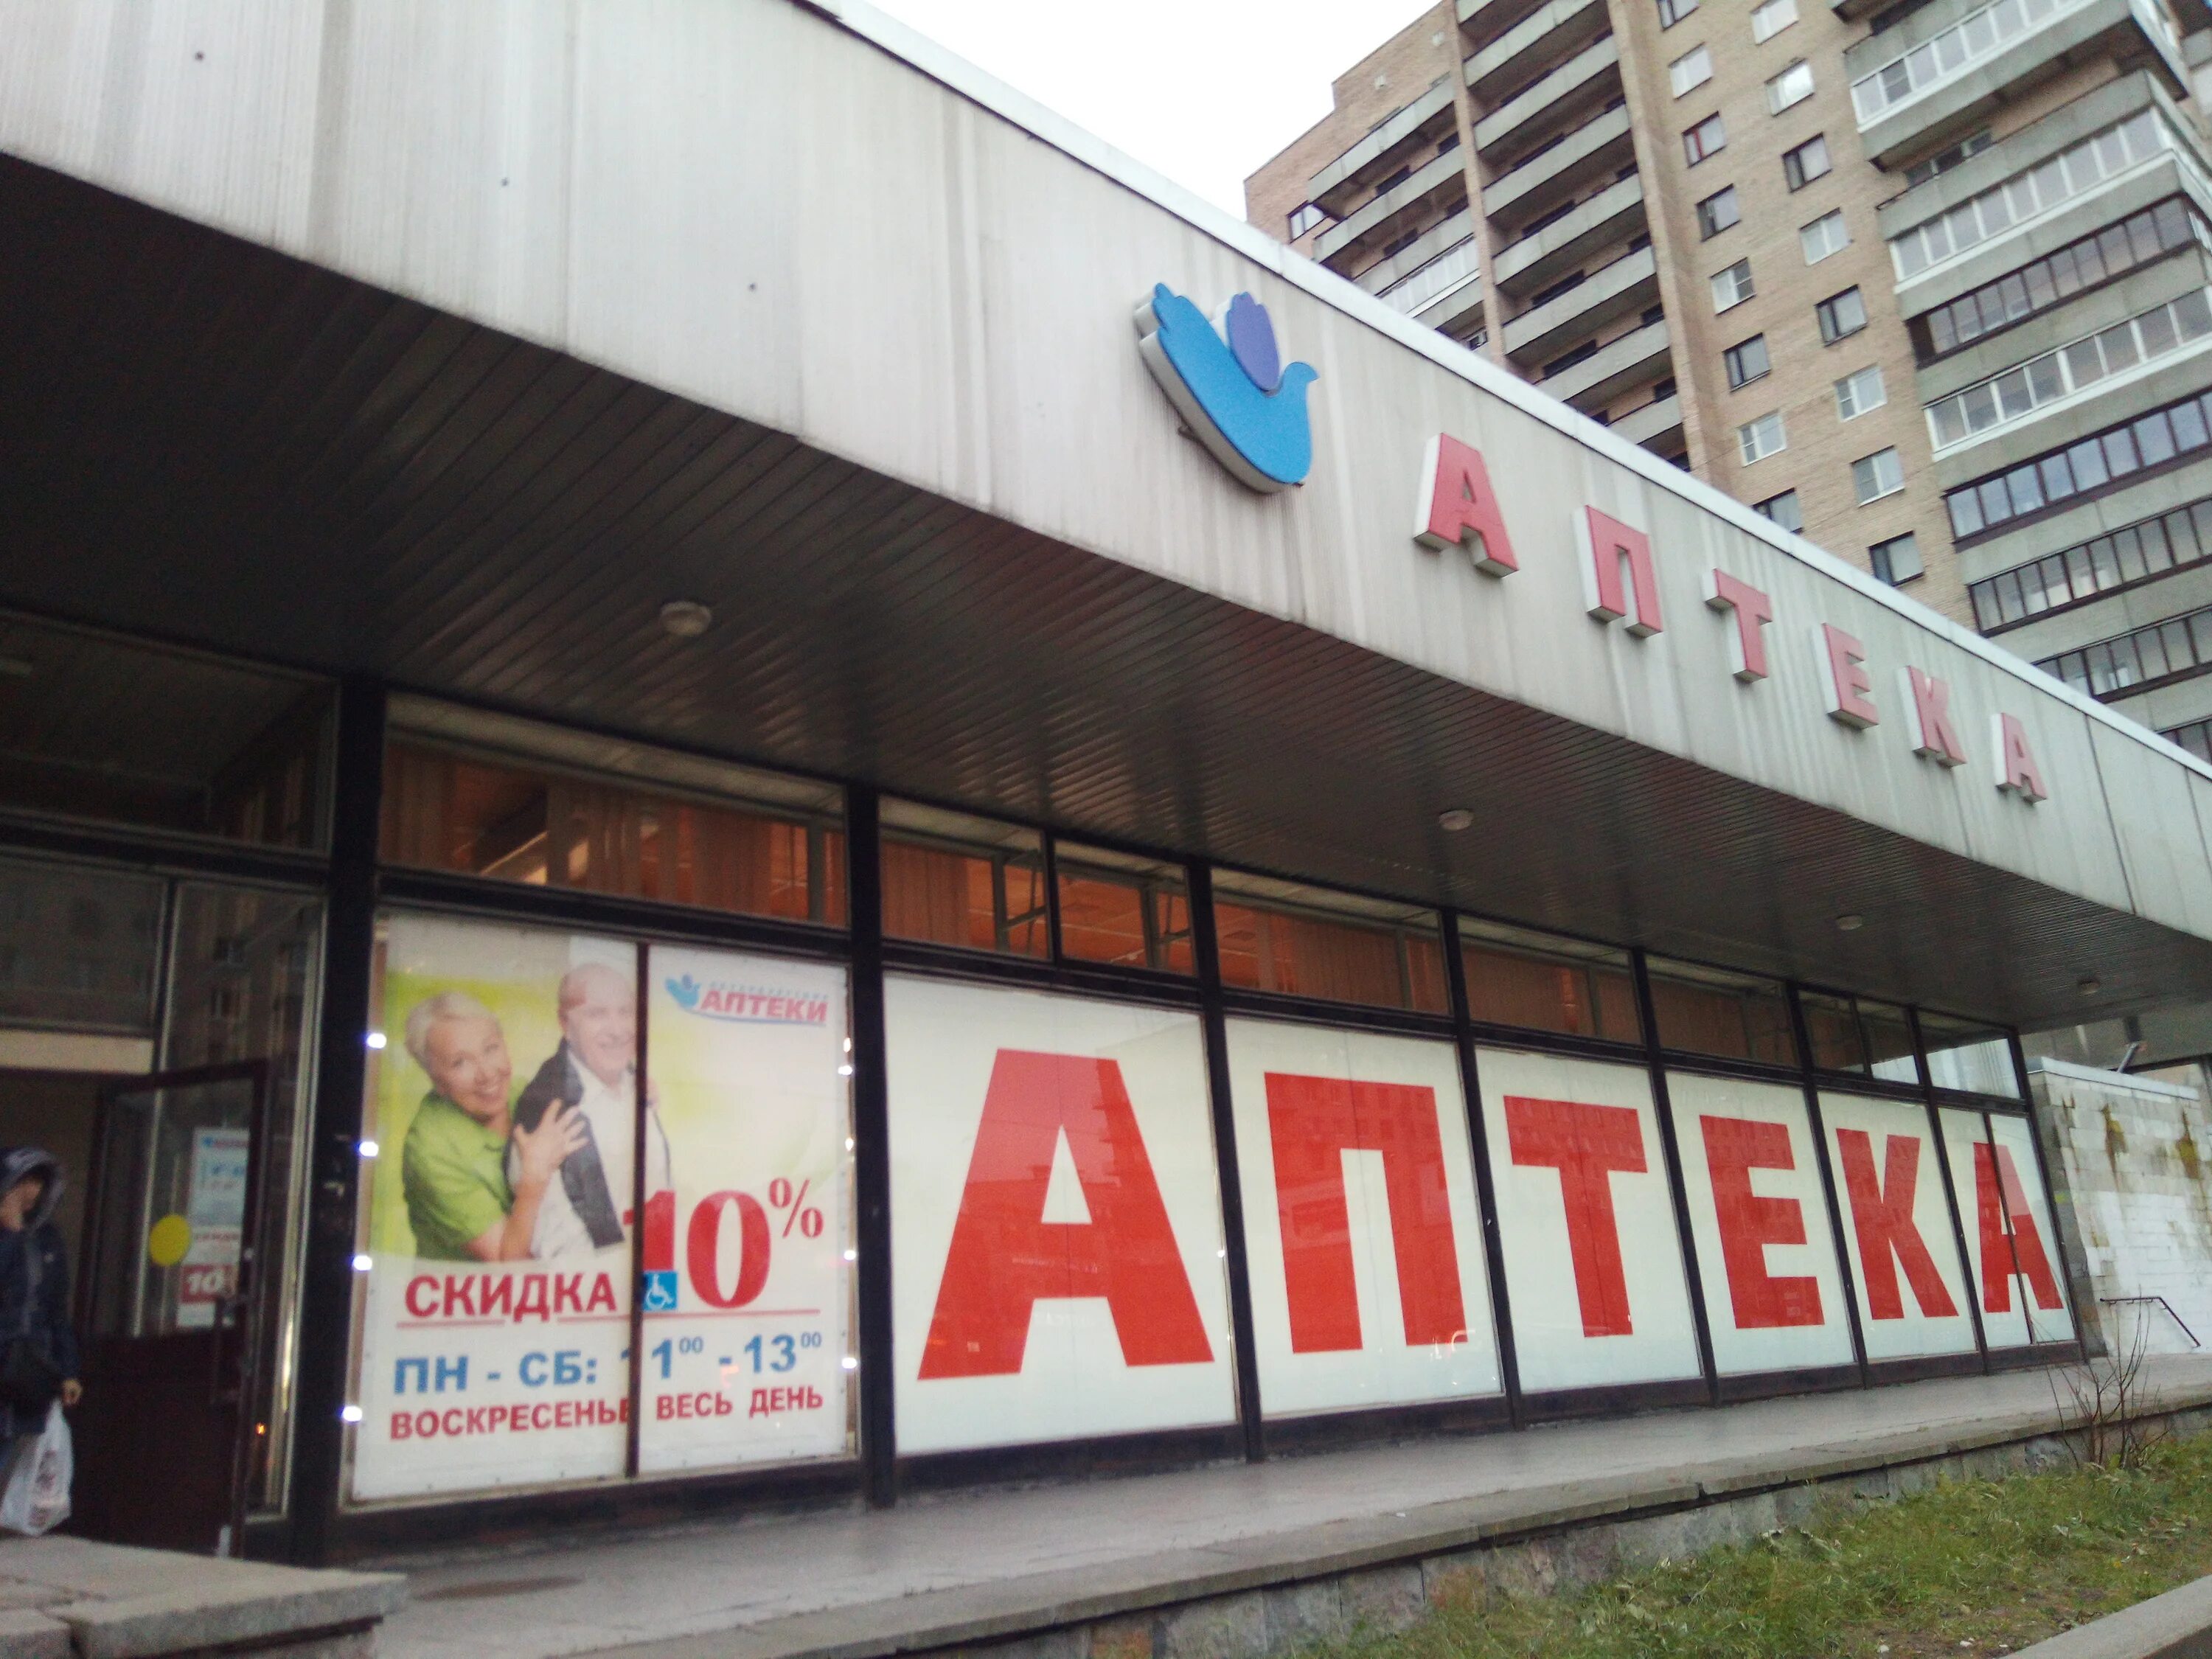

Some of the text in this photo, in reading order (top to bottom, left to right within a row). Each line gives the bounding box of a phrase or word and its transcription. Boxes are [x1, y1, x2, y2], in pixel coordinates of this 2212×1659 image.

[1414, 433, 2048, 803] АПТЕКА
[700, 989, 829, 1022] АПТЕКИ
[917, 1048, 2065, 1381] АПТЕКА
[405, 1272, 617, 1323] СКИДКА
[394, 1355, 468, 1394] ПН
[519, 1350, 597, 1388] СБ:
[655, 1391, 734, 1421] ВЕСЬ
[748, 1385, 825, 1419] ДЕНЬ
